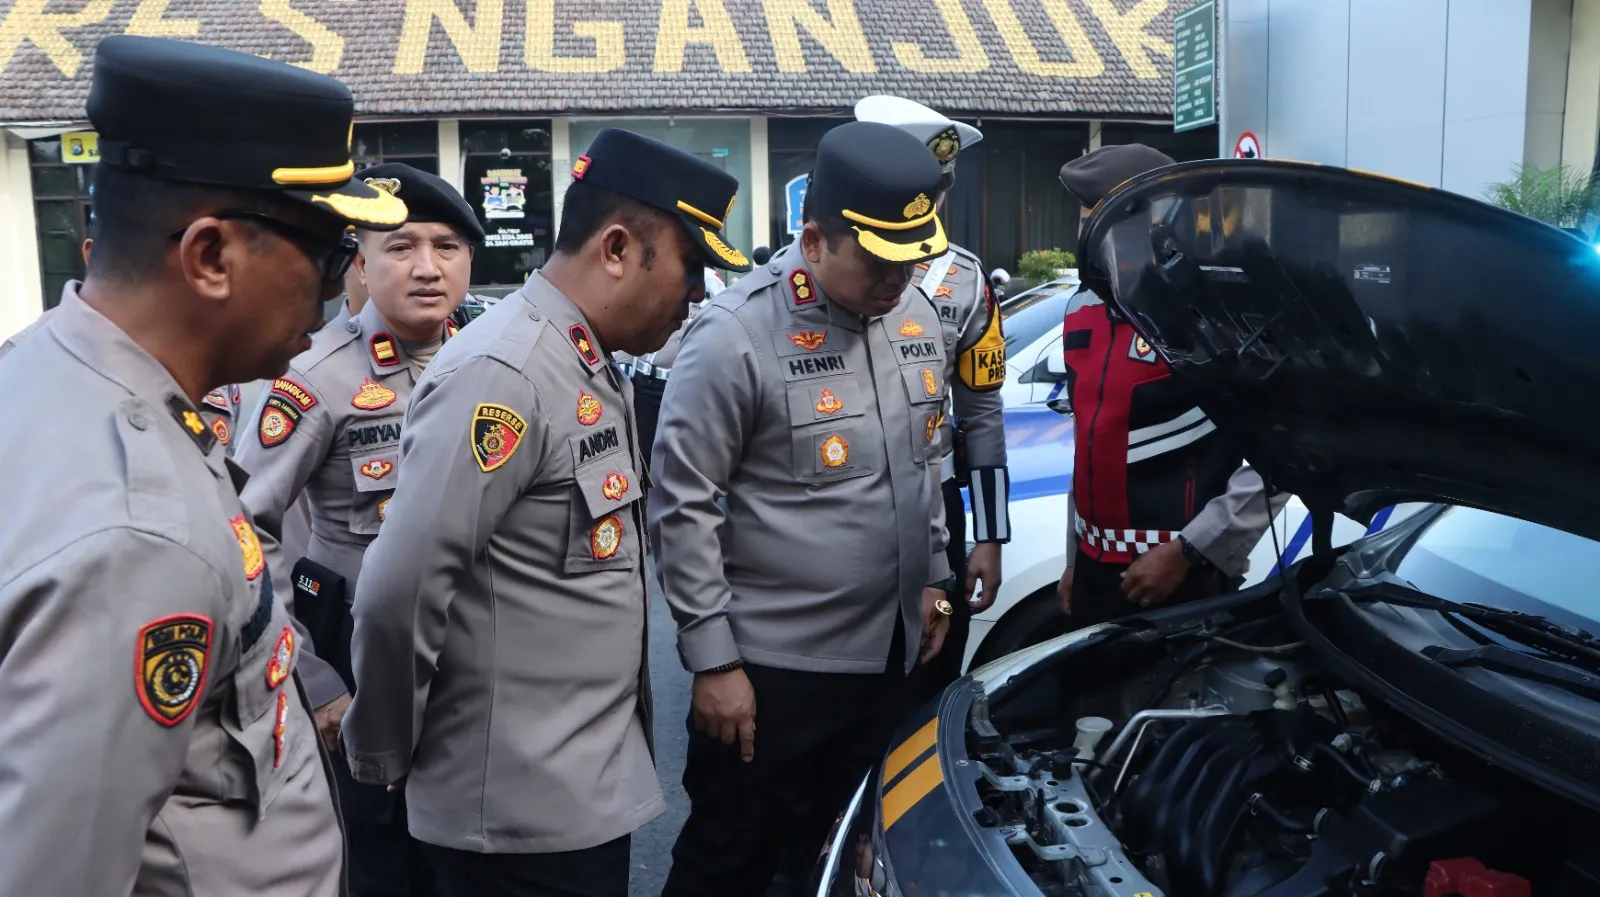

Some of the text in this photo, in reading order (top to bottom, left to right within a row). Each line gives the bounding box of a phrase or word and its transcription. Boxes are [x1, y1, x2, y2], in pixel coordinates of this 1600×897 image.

[394, 0, 1174, 78] NGANJUK
[900, 341, 938, 359] POLRI
[978, 349, 1006, 369] KAS
[788, 355, 846, 376] HENRI
[988, 364, 1006, 383] PRE
[274, 379, 312, 407] BAHARKAM
[482, 407, 522, 430] RESERSE
[579, 426, 619, 463] ANDRI
